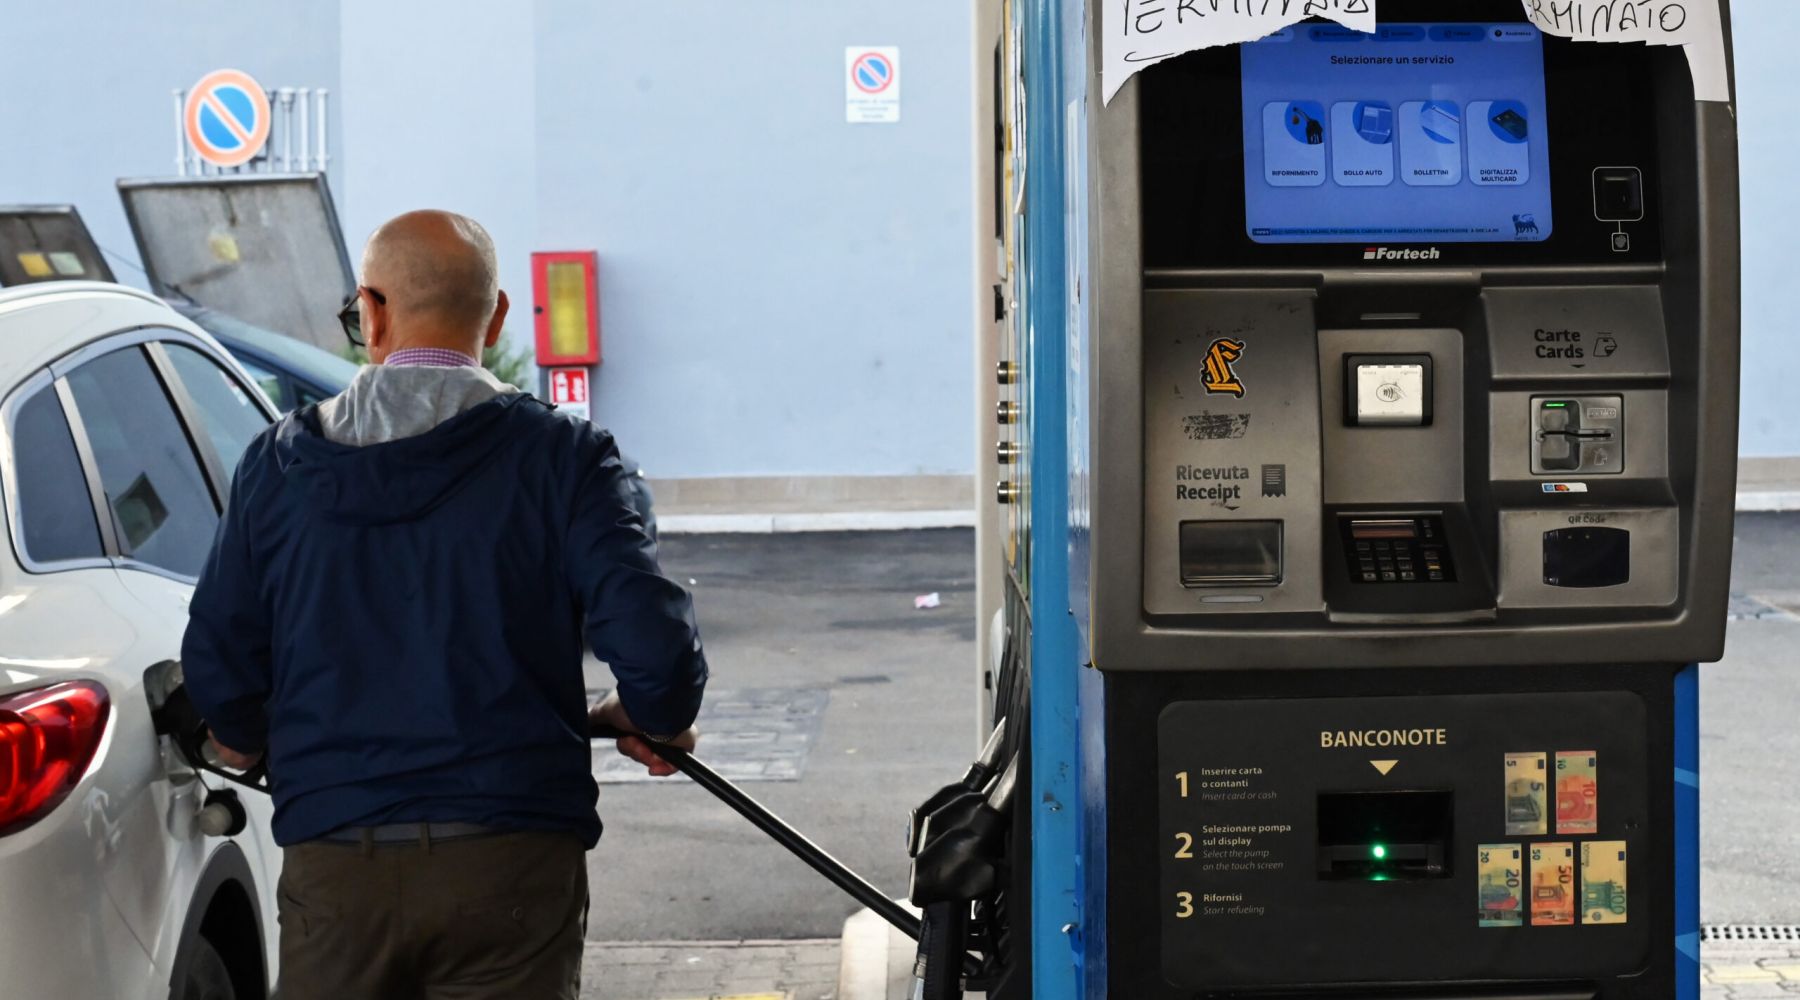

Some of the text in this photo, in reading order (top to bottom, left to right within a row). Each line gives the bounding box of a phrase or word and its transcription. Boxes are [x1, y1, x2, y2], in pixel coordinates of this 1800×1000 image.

[1527, 0, 1686, 37] RMINATO
[1330, 55, 1455, 65] Selezionare un servizio
[1271, 169, 1319, 177] RIFORNIMENTO
[1376, 246, 1440, 260] Fortech
[1534, 328, 1581, 342] Carte
[1535, 343, 1584, 359] Cards
[1176, 464, 1250, 481] Ricevuta
[1176, 482, 1241, 503] Receipt
[1568, 514, 1605, 524] QR Code
[1320, 728, 1447, 748] BANCONOTE
[1201, 767, 1263, 776] Inserire carta
[1175, 771, 1188, 798] 1
[1209, 778, 1249, 788] contanti
[1202, 792, 1226, 800] Insert
[1227, 791, 1246, 800] card
[1257, 790, 1277, 800] cash
[1202, 824, 1292, 835] Selezionare pompa
[1174, 831, 1194, 859] 2
[1202, 836, 1252, 847] sul display
[1202, 848, 1270, 860] Select the pump
[1202, 861, 1284, 871] on the touch screen
[1505, 868, 1520, 888] 20
[1558, 864, 1572, 884] 50
[1203, 893, 1243, 902] Rifornisi
[1175, 891, 1194, 918] 3
[1203, 904, 1265, 916] Start refueling
